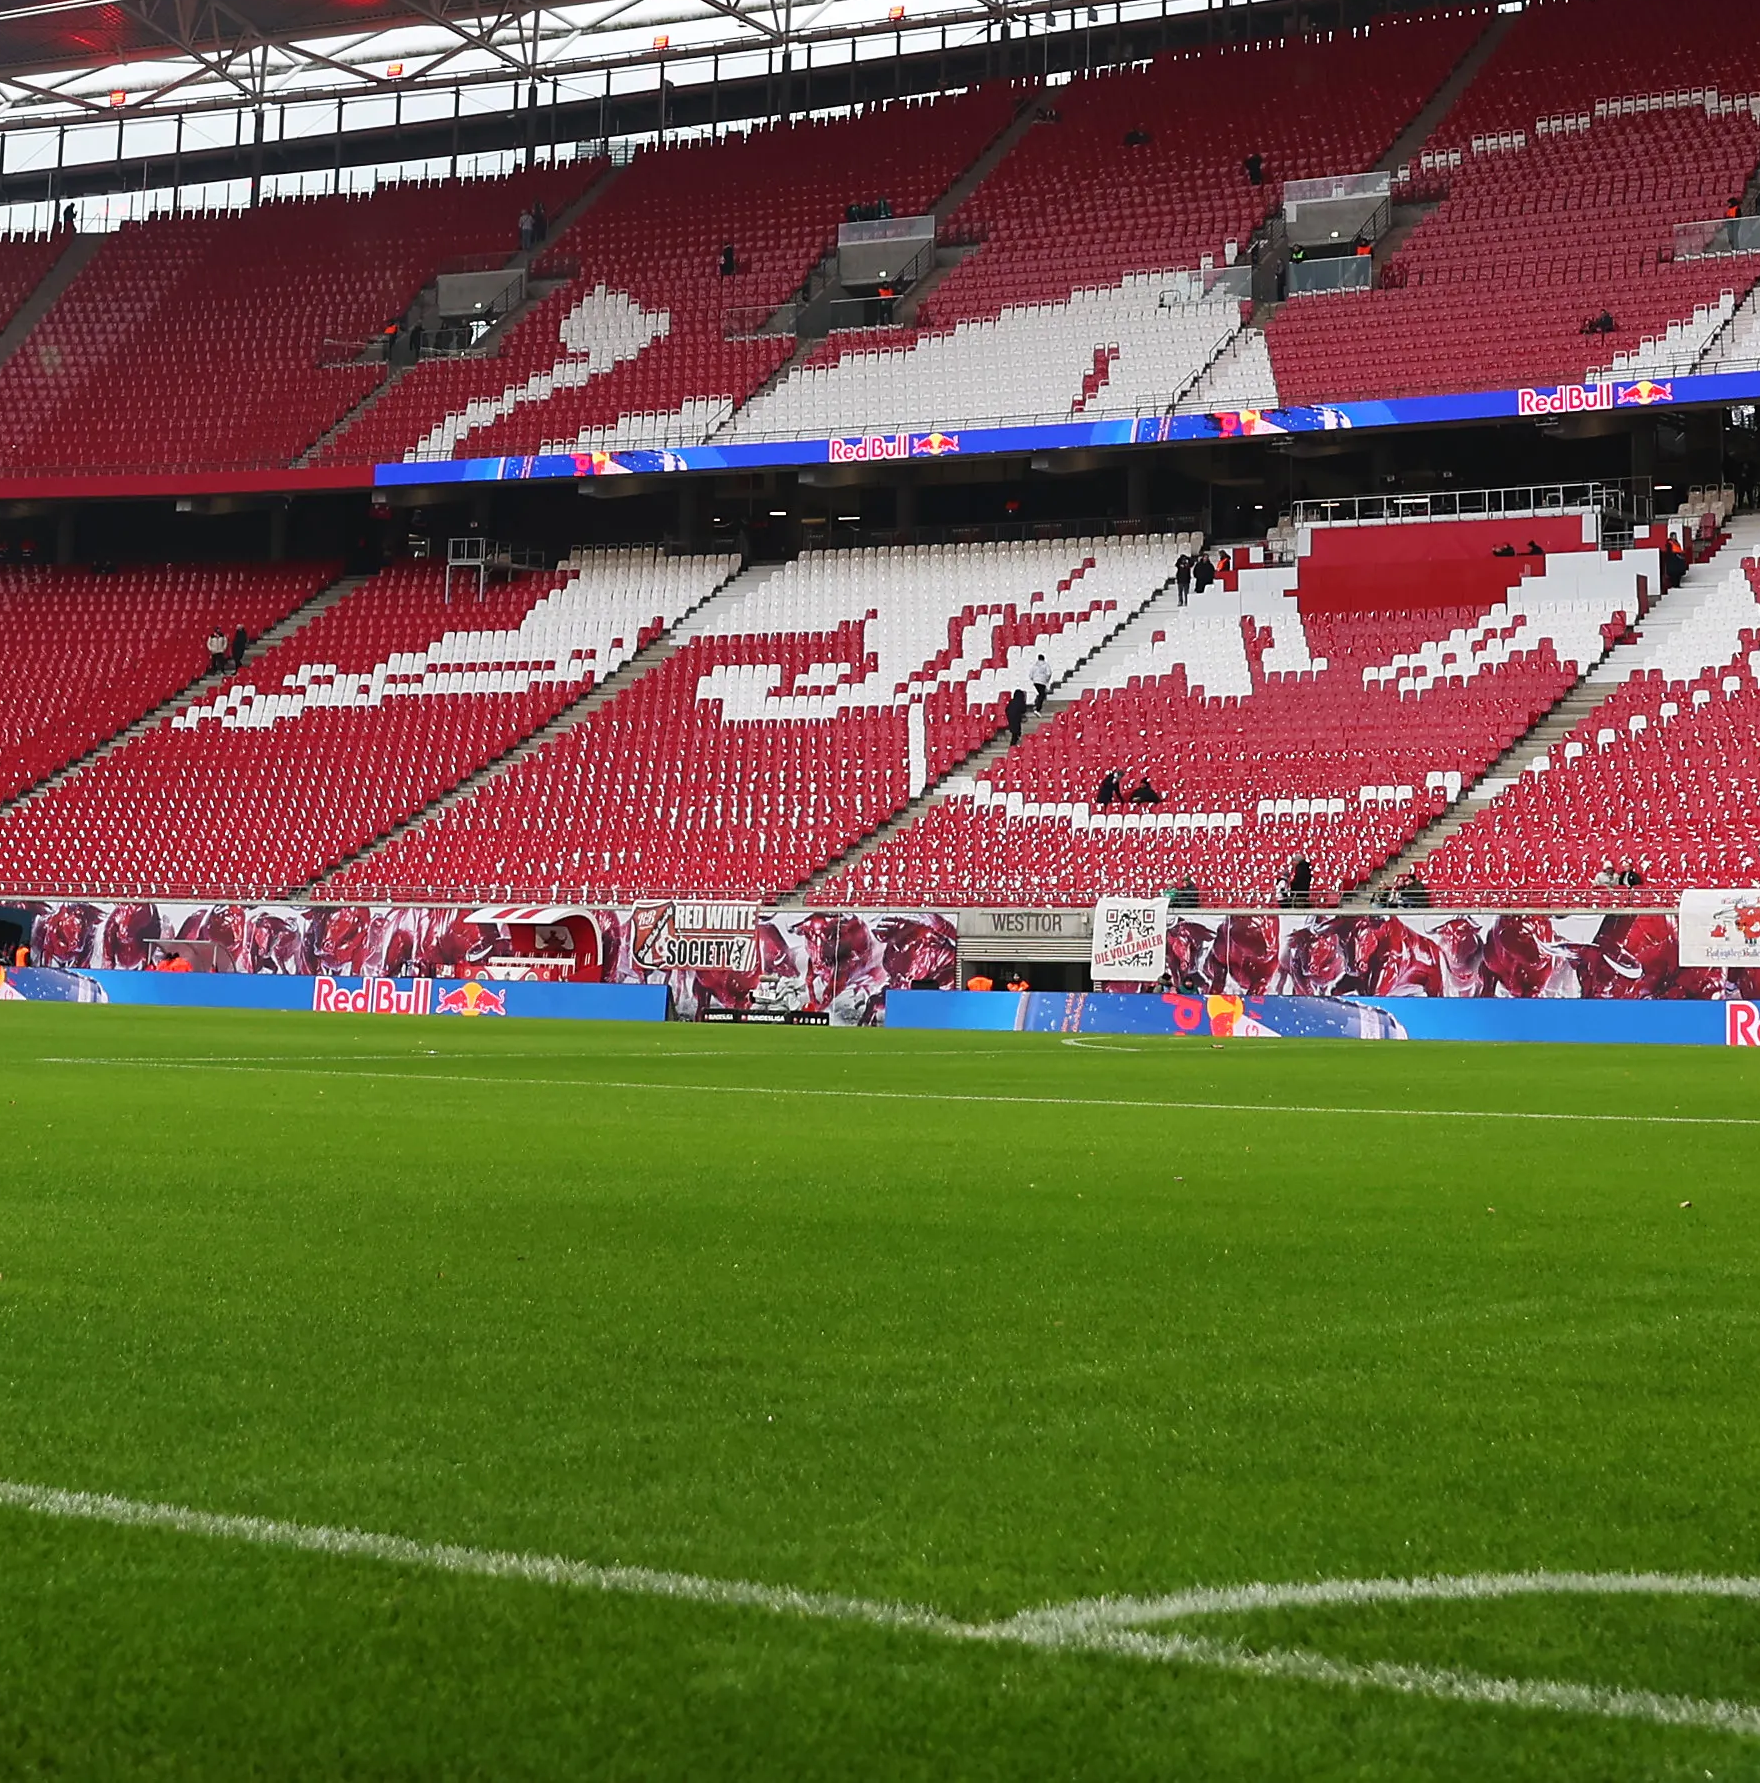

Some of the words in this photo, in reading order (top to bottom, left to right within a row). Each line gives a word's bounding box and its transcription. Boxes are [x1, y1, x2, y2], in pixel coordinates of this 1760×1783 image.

[1519, 385, 1566, 415] Red
[1566, 382, 1613, 411] Bull
[829, 436, 869, 463] Red
[869, 433, 909, 460] Bull
[674, 905, 703, 929] RED
[706, 905, 756, 930] WHITE
[992, 912, 1062, 933] WESTTOR
[666, 939, 734, 966] SOCIETY
[1095, 951, 1109, 965] DIE
[313, 976, 373, 1013] Red
[373, 977, 432, 1015] Bull
